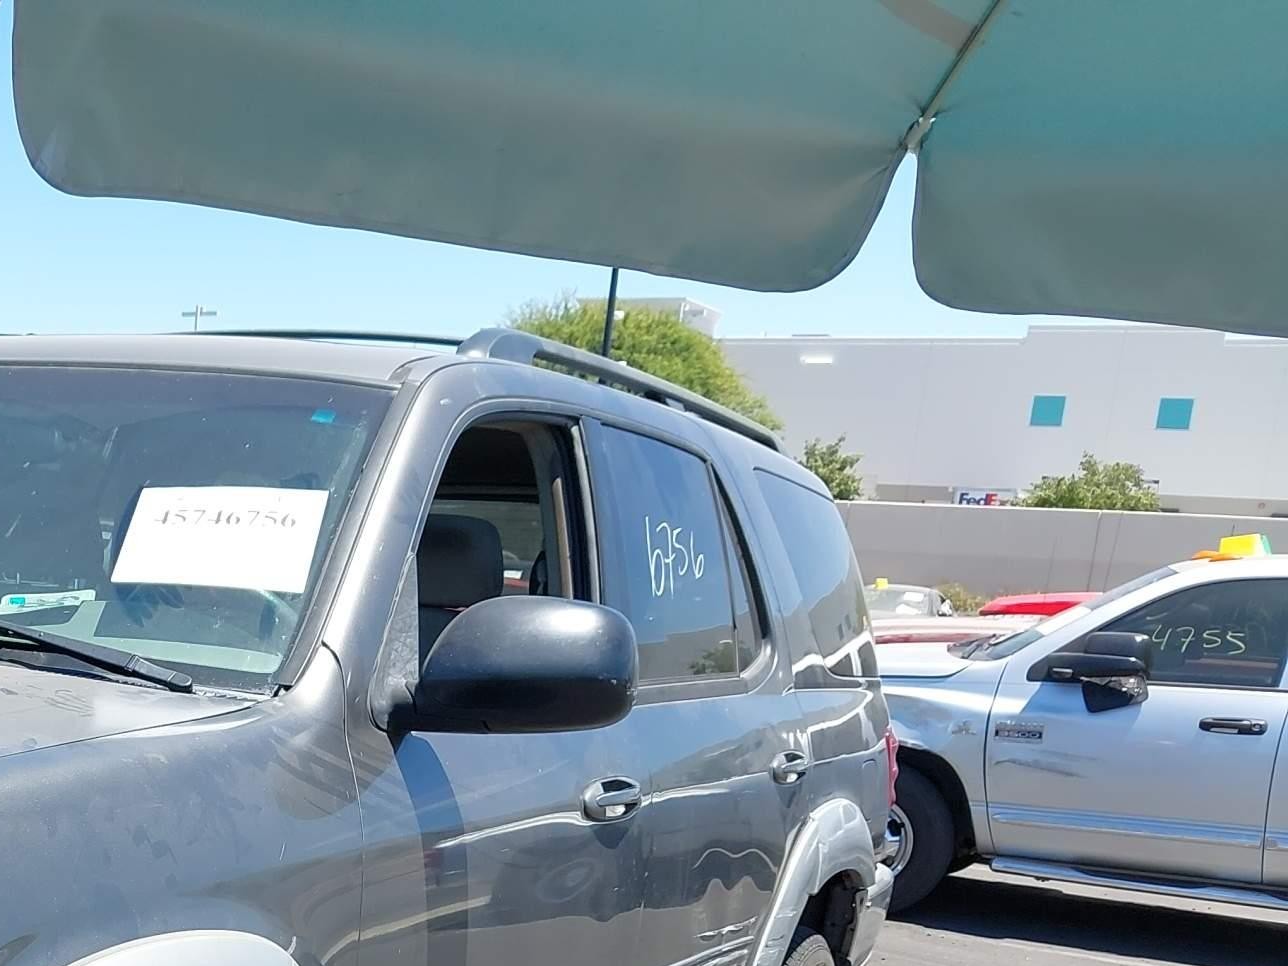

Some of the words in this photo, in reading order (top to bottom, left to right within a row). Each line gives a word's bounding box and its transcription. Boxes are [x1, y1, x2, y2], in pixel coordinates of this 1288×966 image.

[155, 508, 297, 528] 45746756
[645, 516, 705, 599] 6756
[1152, 624, 1246, 655] 4755
